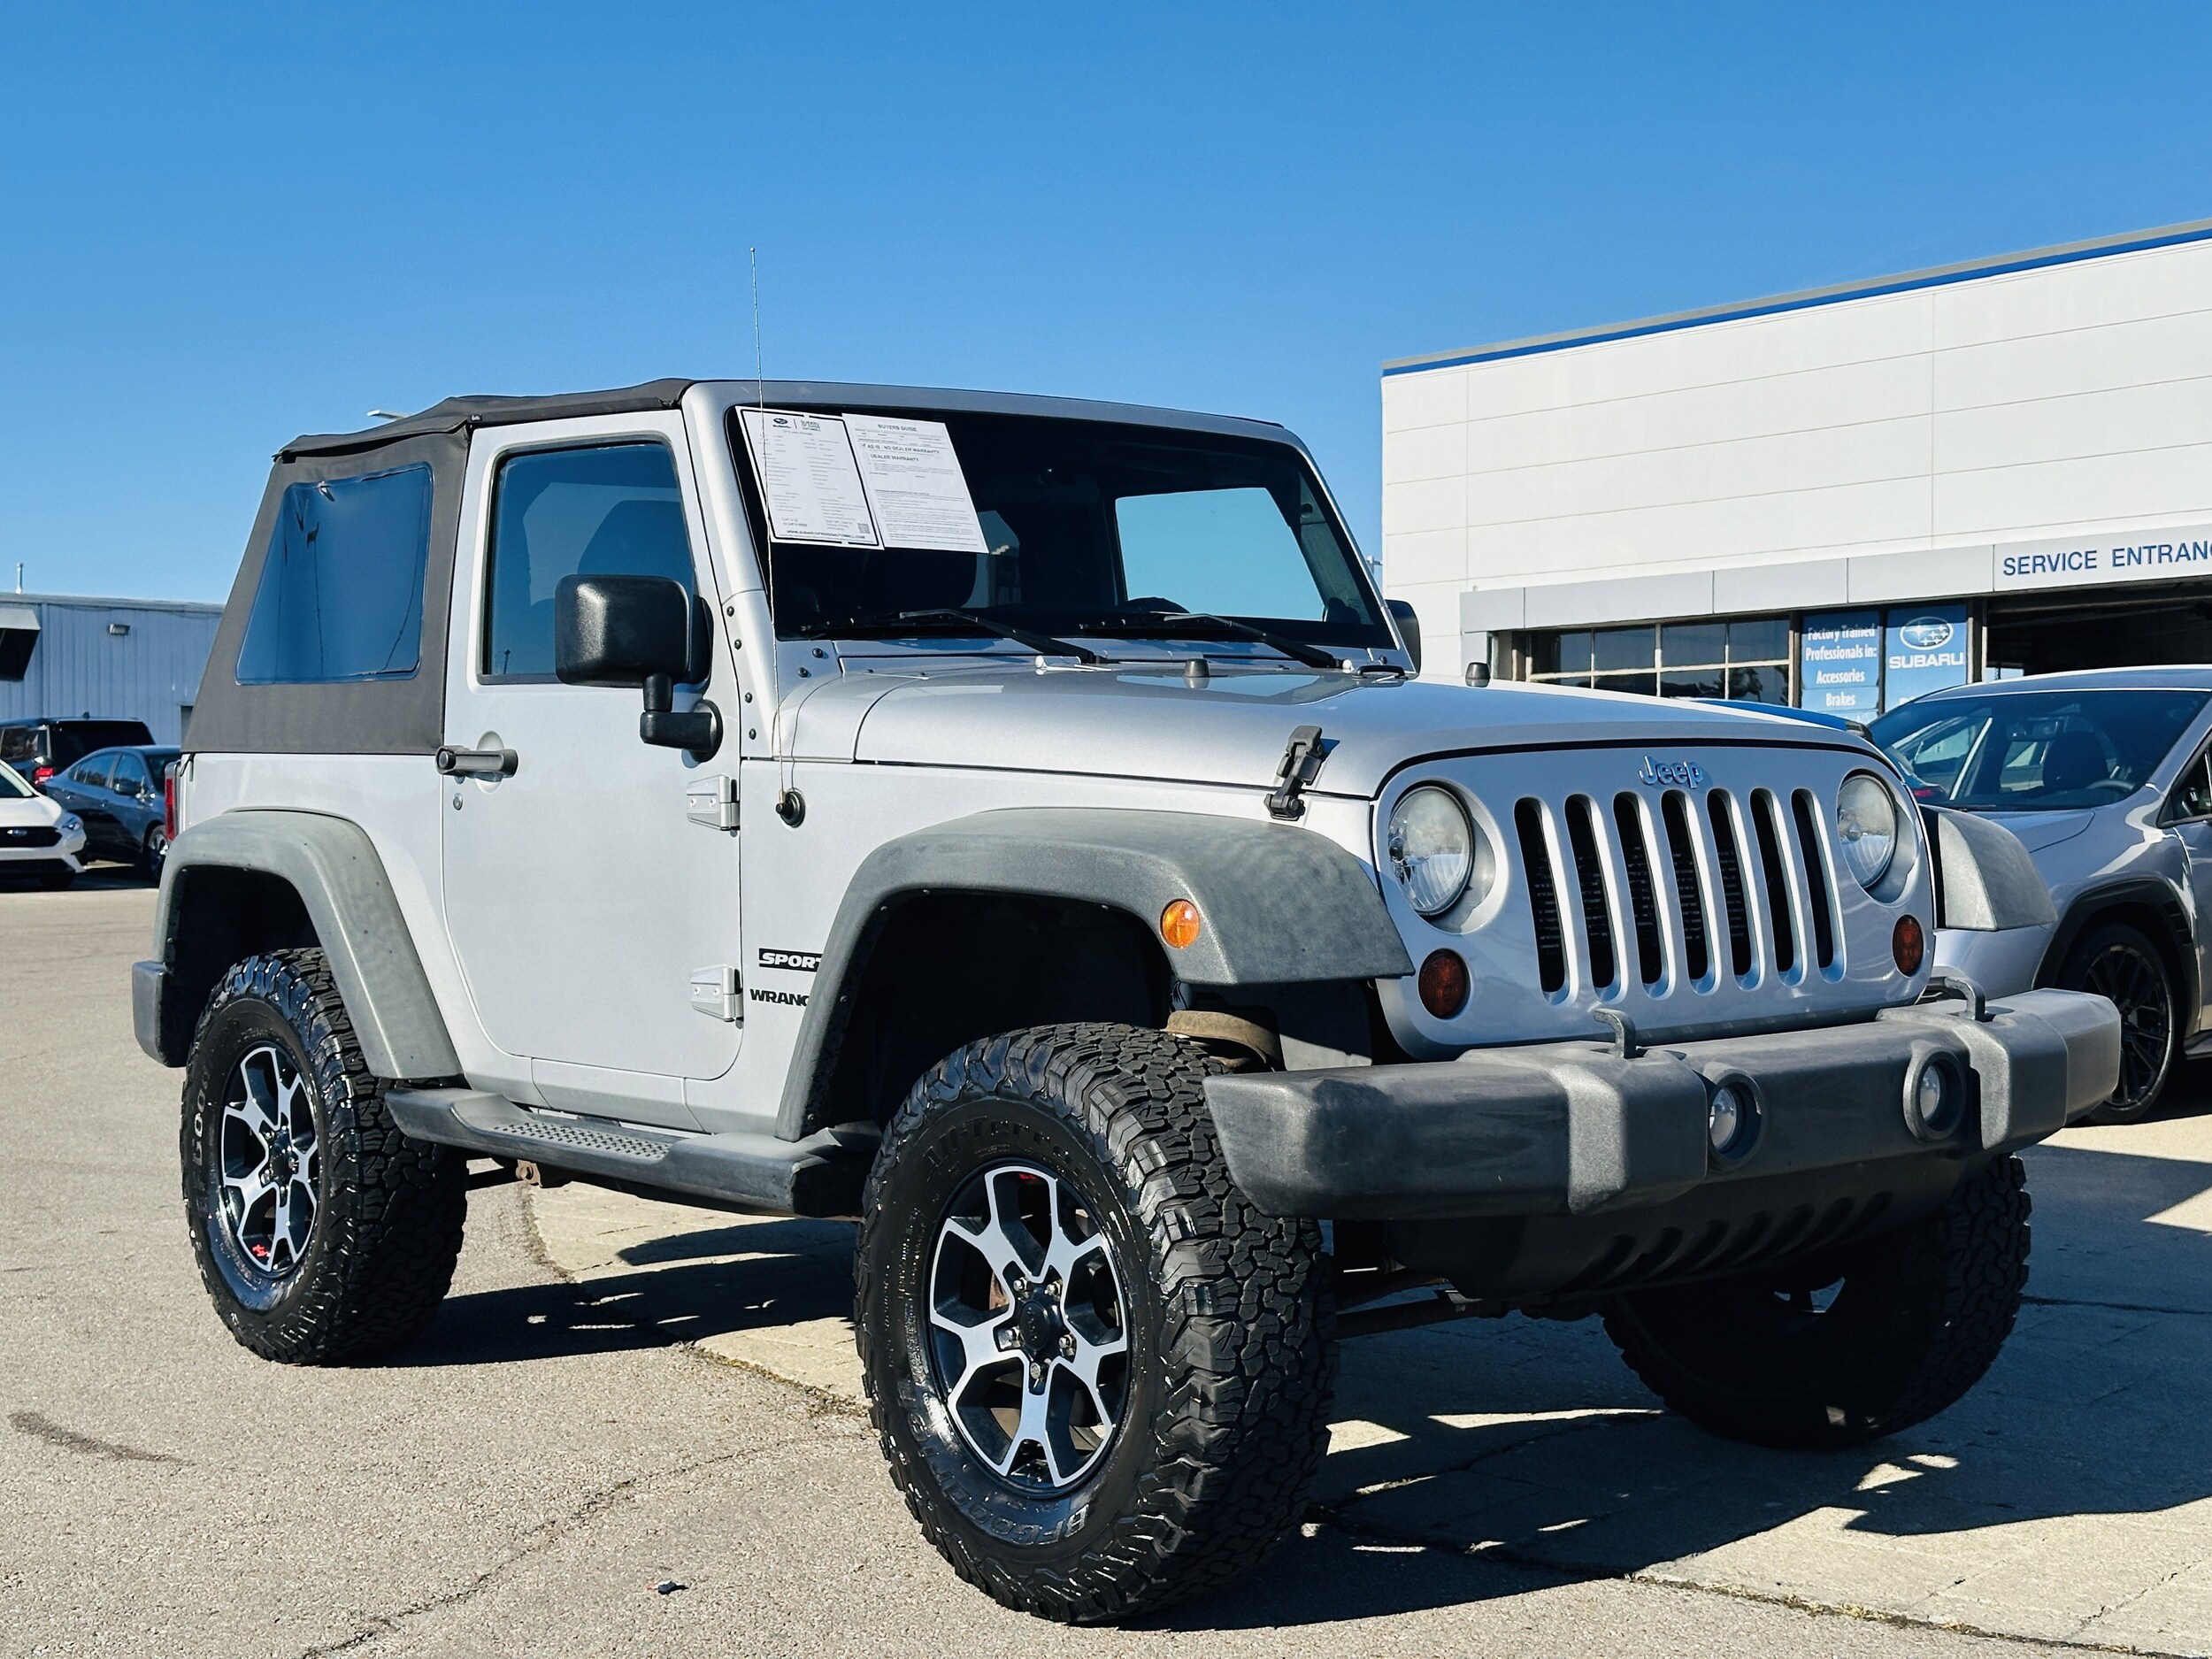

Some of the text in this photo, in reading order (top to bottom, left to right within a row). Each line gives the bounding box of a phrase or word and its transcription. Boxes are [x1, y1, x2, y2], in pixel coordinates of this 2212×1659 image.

[2002, 540, 2212, 576] SERVICE ENTRAN
[1808, 623, 1876, 642] Factory Trained
[1805, 643, 1878, 661] Professionals in:
[1888, 651, 1964, 670] SUBARU
[1816, 669, 1865, 684] Accessories
[1825, 692, 1855, 707] Brakes
[1638, 755, 1703, 788] Jeep
